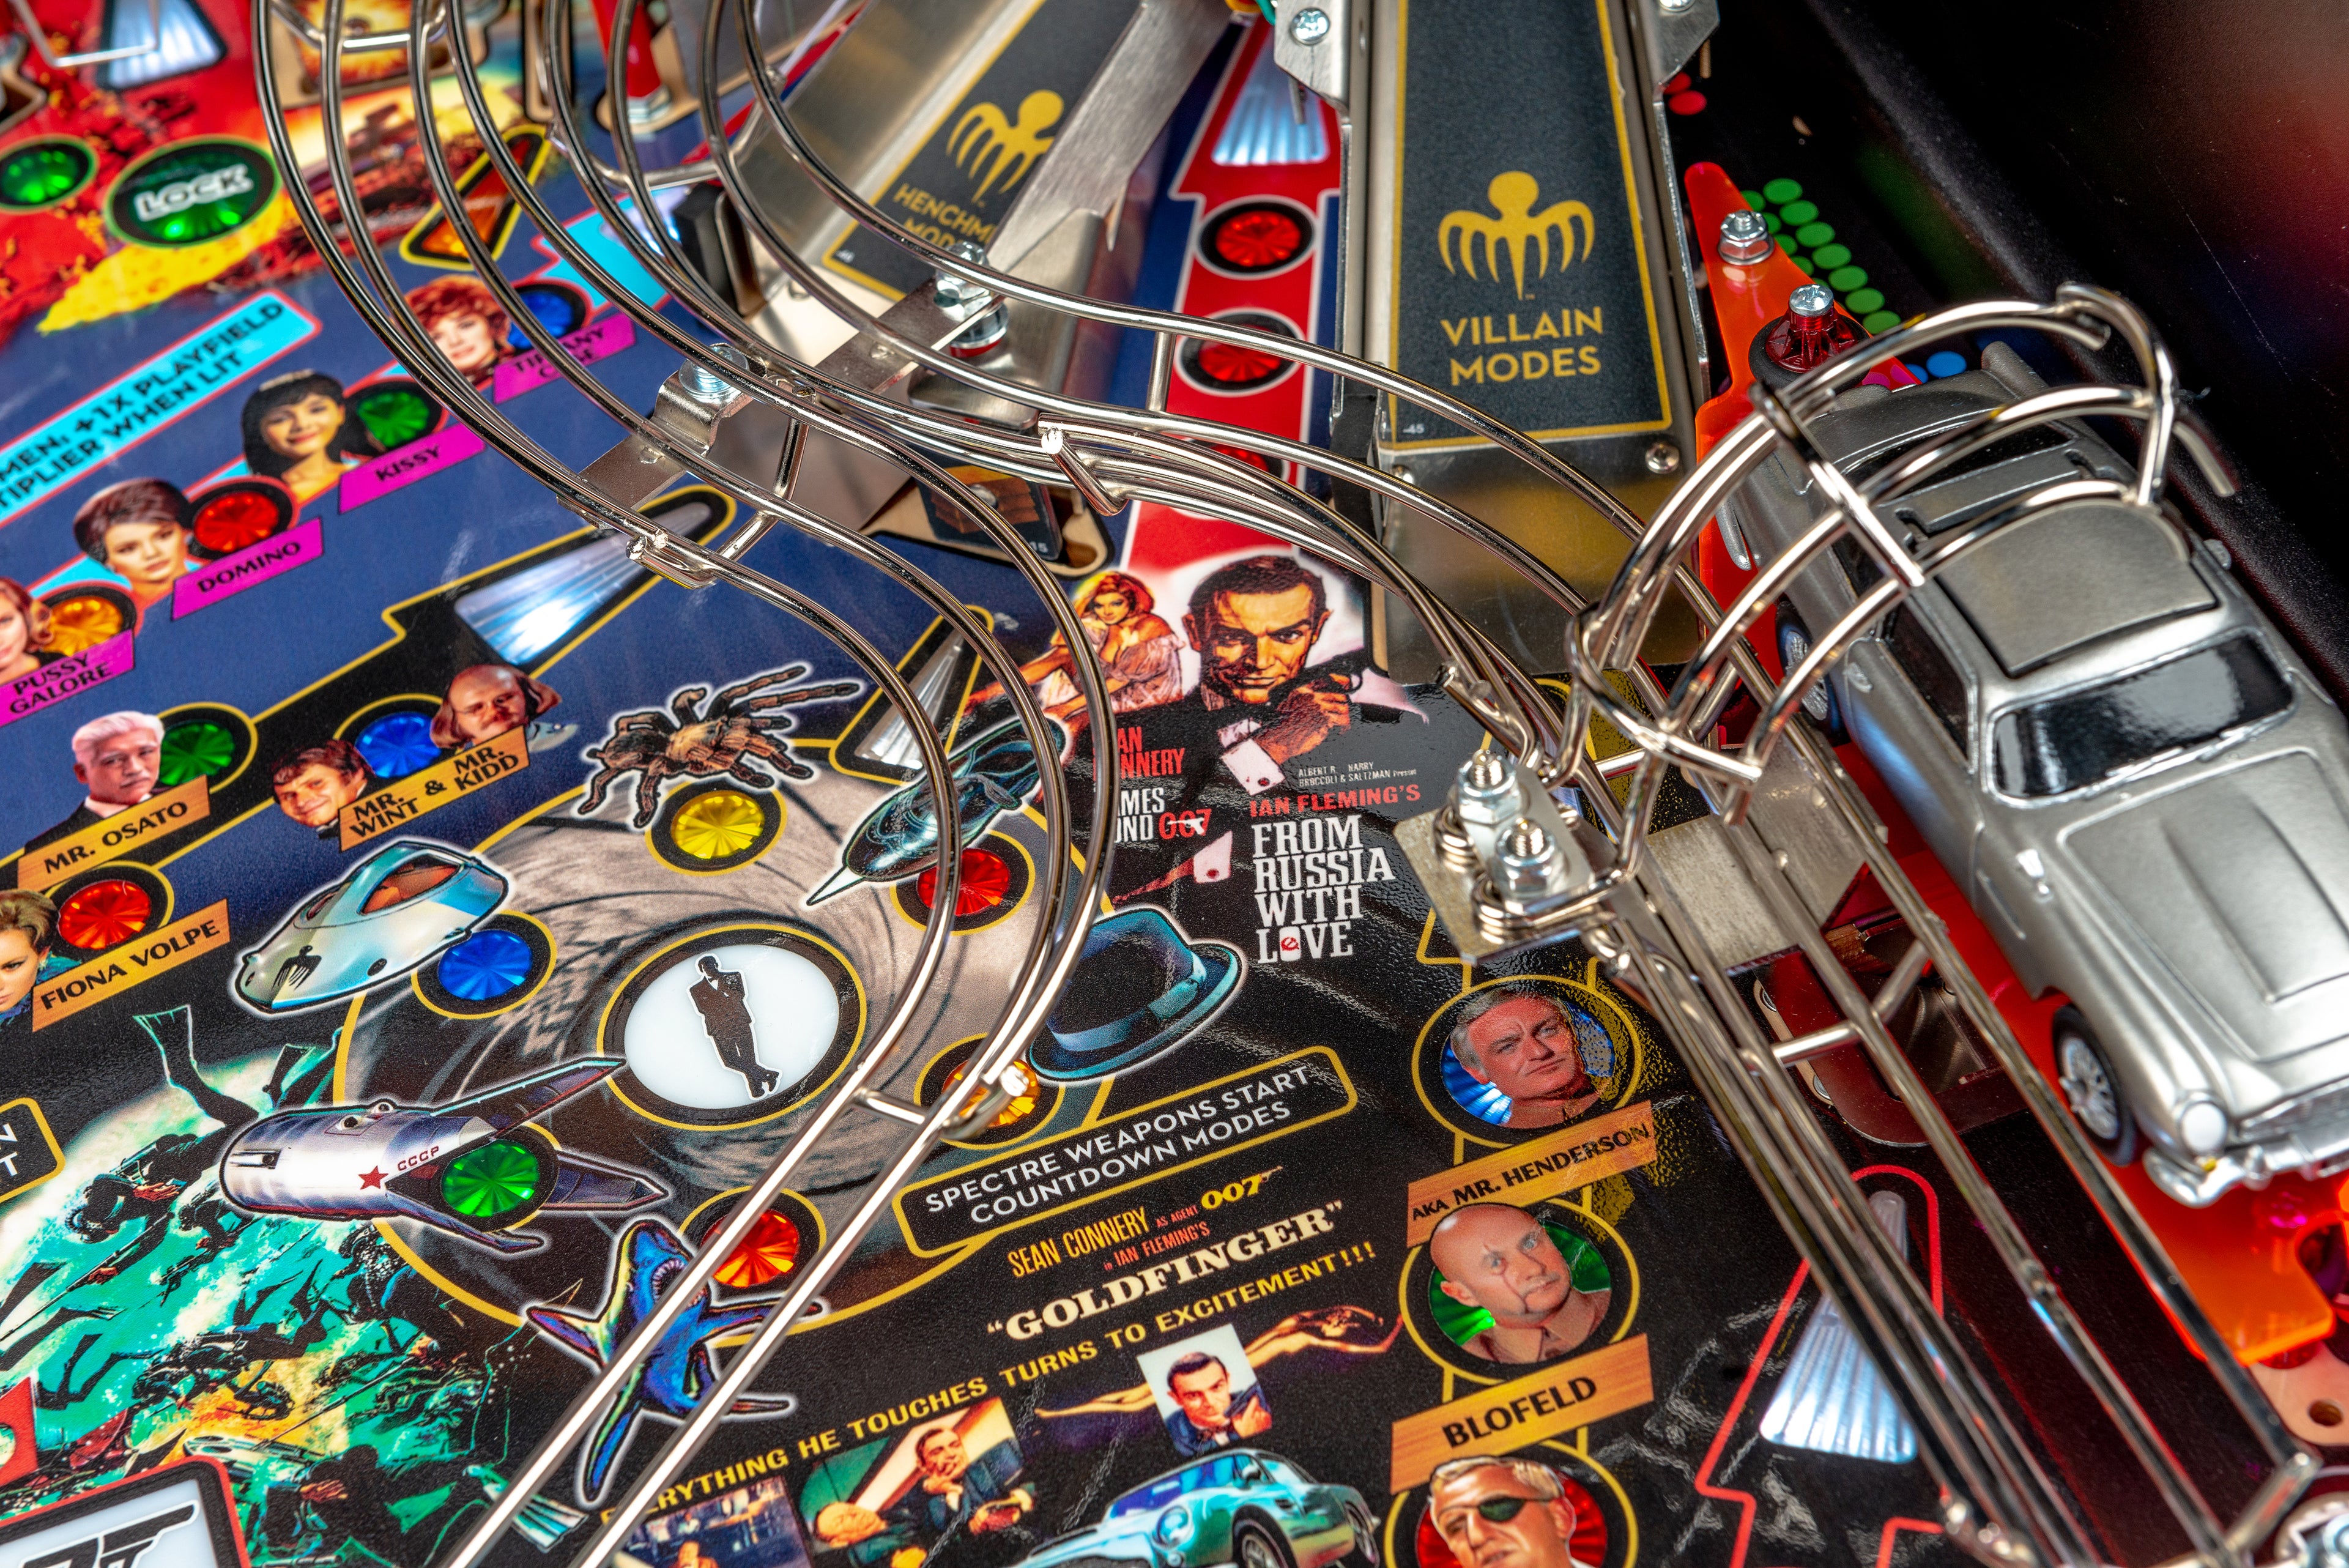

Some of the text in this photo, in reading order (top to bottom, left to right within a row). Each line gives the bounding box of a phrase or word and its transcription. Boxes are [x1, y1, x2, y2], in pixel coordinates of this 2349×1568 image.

[133, 164, 254, 221] LOCK
[904, 218, 964, 247] MOD
[1441, 306, 1603, 346] VILLAIN
[75, 395, 133, 432] +1X
[134, 303, 283, 396] PLAYFIELD
[1450, 346, 1601, 386] MODES
[102, 381, 197, 438] WHEN
[197, 350, 242, 384] LIT
[375, 445, 440, 481] KISSY
[197, 541, 301, 593] DOMINO
[10, 661, 114, 713] GALORE
[13, 653, 89, 695] PUSSY
[453, 746, 505, 775] MR.
[454, 754, 519, 791] KIDD
[1093, 748, 1185, 782] NNERY
[1299, 766, 1327, 777] ALBERT
[1348, 762, 1373, 771] HARRY
[1299, 775, 1337, 787] BROCCOLI
[1340, 775, 1346, 783] &
[1348, 770, 1390, 782] SALTZMAN
[353, 792, 404, 821] MR.
[425, 779, 447, 796] &
[1093, 787, 1165, 817] MES
[1250, 784, 1421, 817] IAN FLEMING'S
[43, 801, 188, 874] MR. OSATO
[349, 797, 419, 838] WINT
[1159, 809, 1212, 840] 007
[1252, 815, 1364, 858] FROM
[1253, 847, 1396, 893] RUSSIA
[1255, 885, 1363, 927] WITH
[1256, 920, 1353, 964] LOVE
[41, 920, 220, 1010] FIONA VOLPE
[397, 1145, 439, 1171] CCCP
[926, 1065, 1312, 1213] SPECTRE WEAPONS START
[970, 1102, 1292, 1224] COUNTDOWN MODES
[1412, 1123, 1652, 1221] AKA MR. HENDERSON
[1008, 1174, 1262, 1277] SEAN CONNERY AS AGENT 007
[1113, 1246, 1140, 1267] IAN
[1142, 1221, 1211, 1257] FLEMING'S
[600, 1241, 1376, 1525] RYTHING HE TOUCHES TURNS TO EXCITEMENT!!!
[1442, 1376, 1597, 1448] BLOFELD
